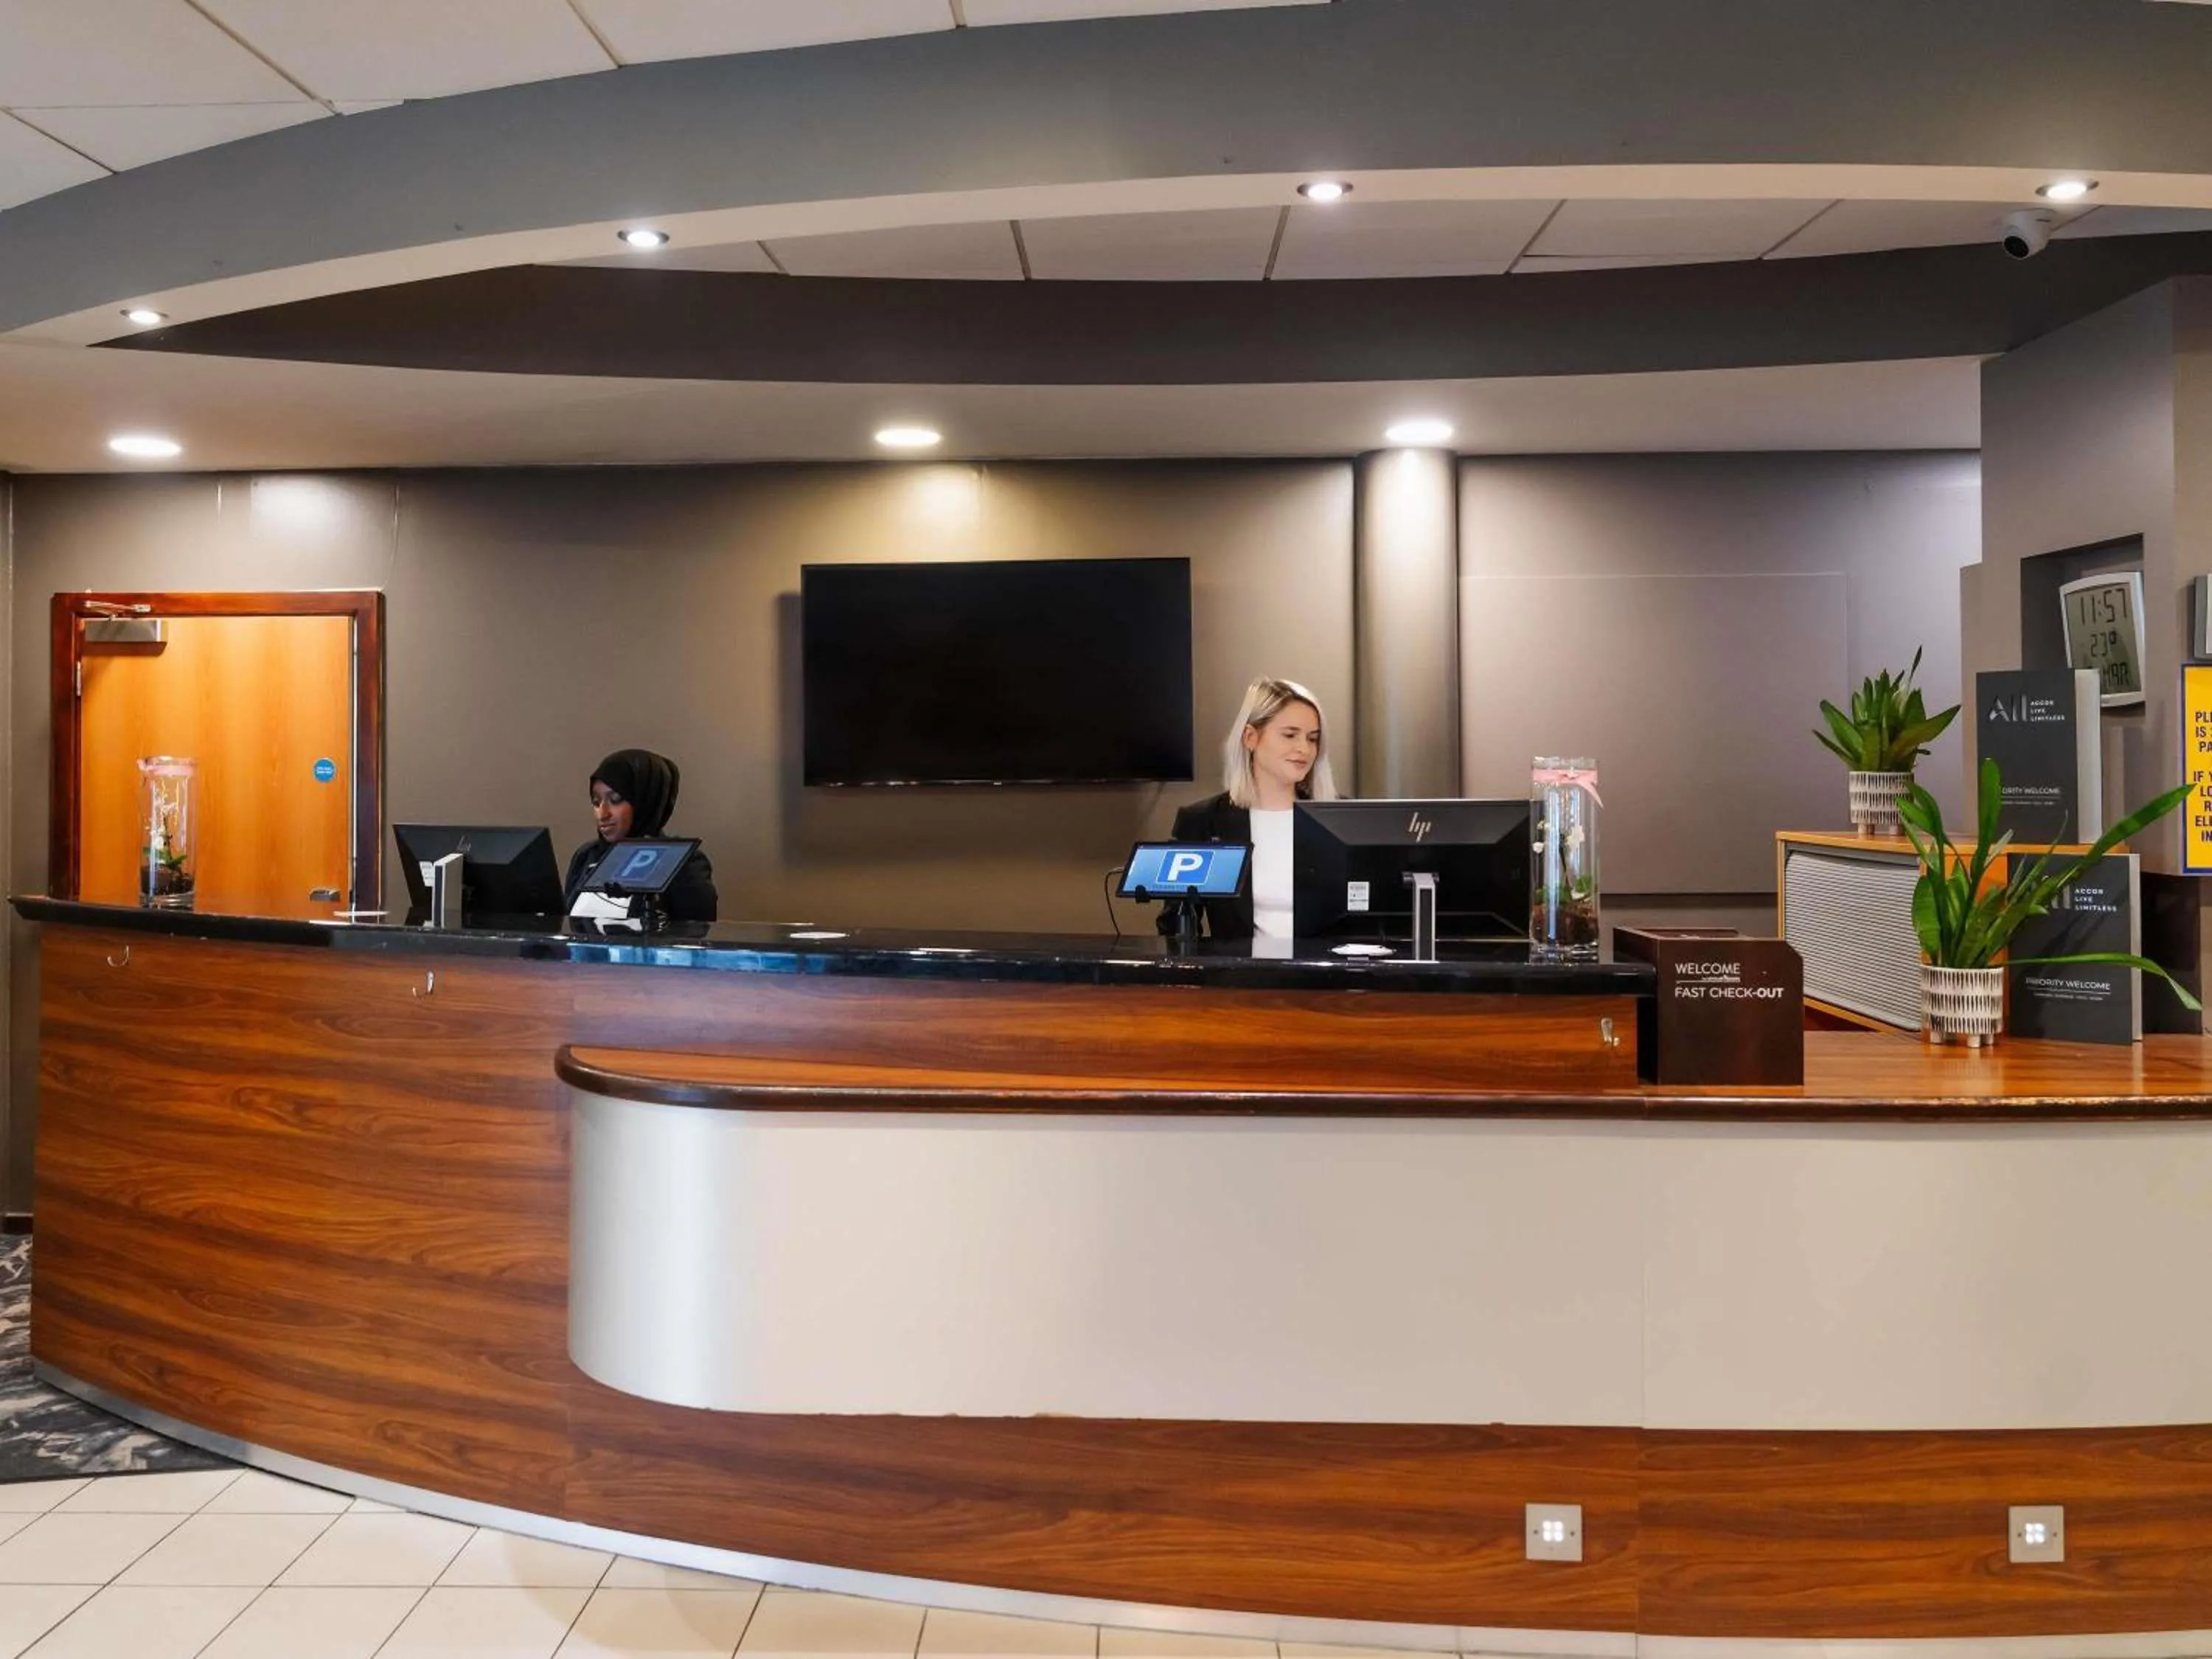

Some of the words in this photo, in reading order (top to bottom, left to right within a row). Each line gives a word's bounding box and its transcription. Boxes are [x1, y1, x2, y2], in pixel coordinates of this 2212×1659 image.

[2080, 588, 2127, 625] 11:57
[2195, 711, 2212, 723] PL
[2195, 726, 2206, 738] IS
[2194, 771, 2203, 782] IF
[1409, 812, 1431, 842] hp
[621, 849, 658, 877] P
[1167, 853, 1204, 881] P
[1674, 962, 1741, 975] WELCOME
[2065, 980, 2111, 990] WELCOME
[1674, 987, 1706, 998] FAST
[1709, 987, 1784, 998] CHECK-OUT
